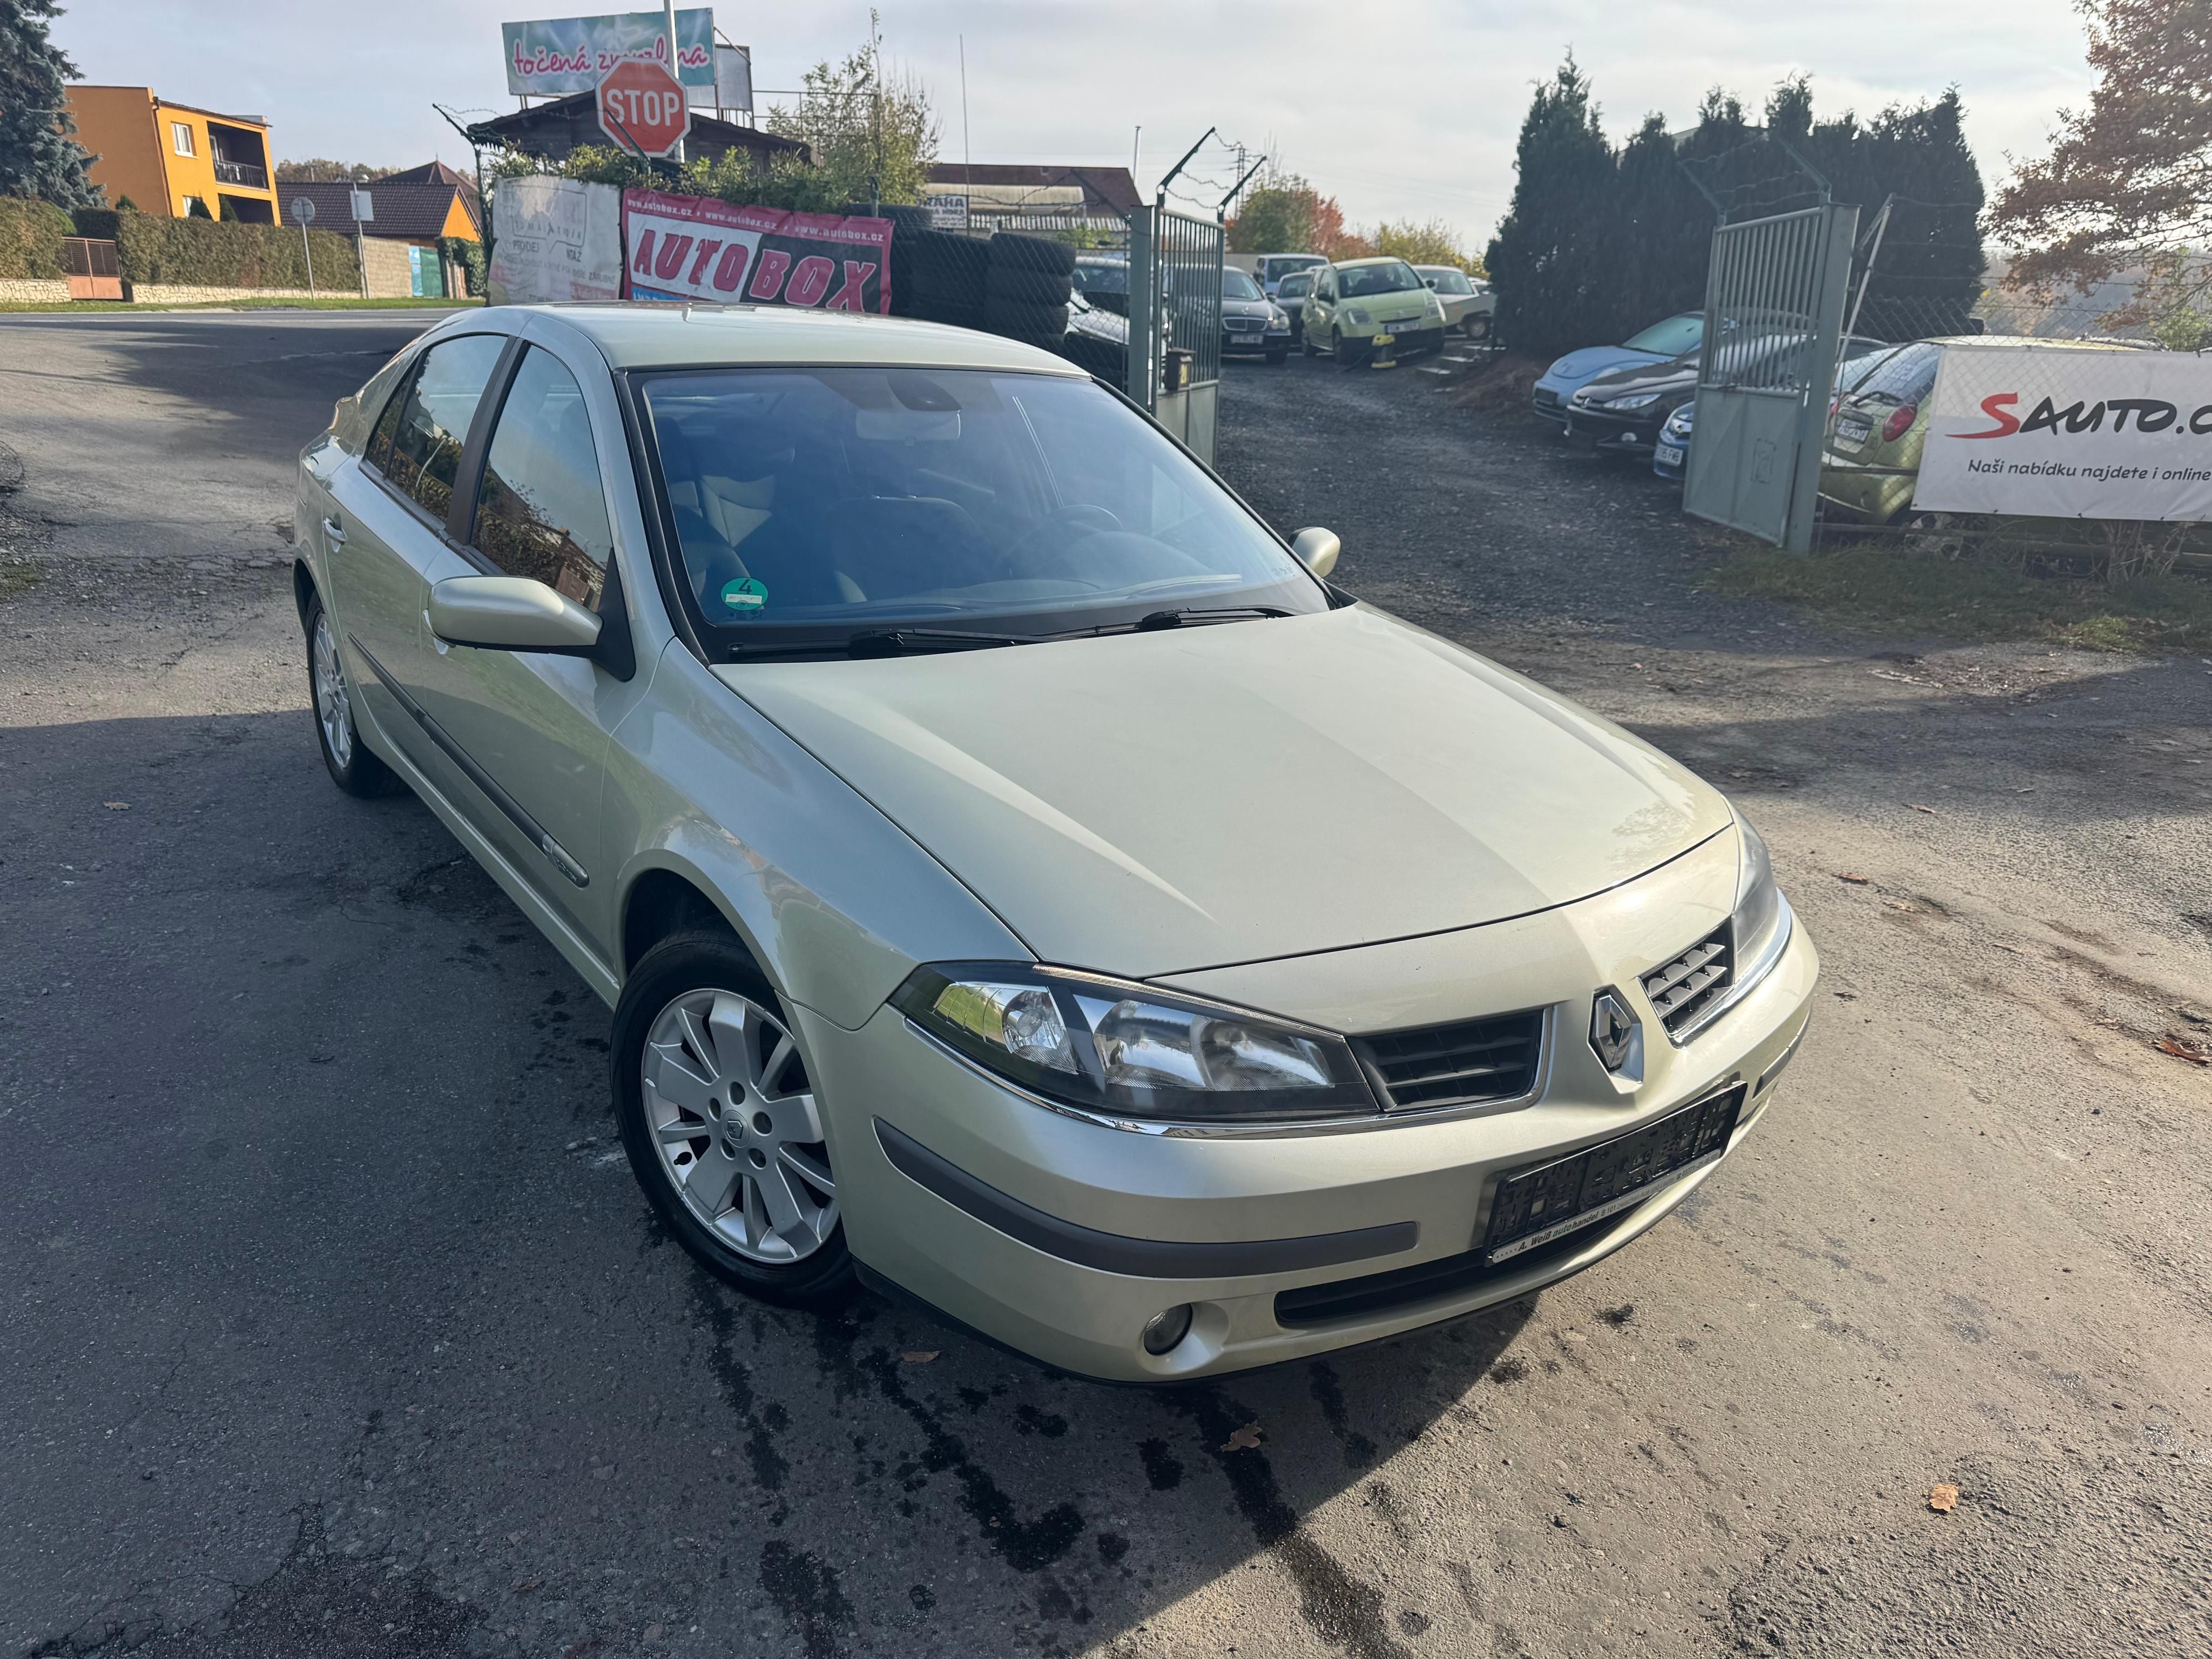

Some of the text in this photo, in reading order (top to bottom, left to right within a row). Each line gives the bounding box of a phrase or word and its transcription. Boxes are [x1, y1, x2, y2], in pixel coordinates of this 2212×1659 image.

[514, 42, 591, 73] točená
[606, 89, 679, 126] STOP
[628, 199, 884, 242] www.autobox.cz www.autobox.cz www.autobox.cz
[633, 228, 876, 313] AUTOBOX
[1967, 458, 2212, 482] Naši nabídku najdete i online
[738, 579, 752, 595] 4
[1518, 1242, 1527, 1252] A.
[1530, 1231, 1552, 1246] Weiß
[1606, 1204, 1616, 1215] 101
